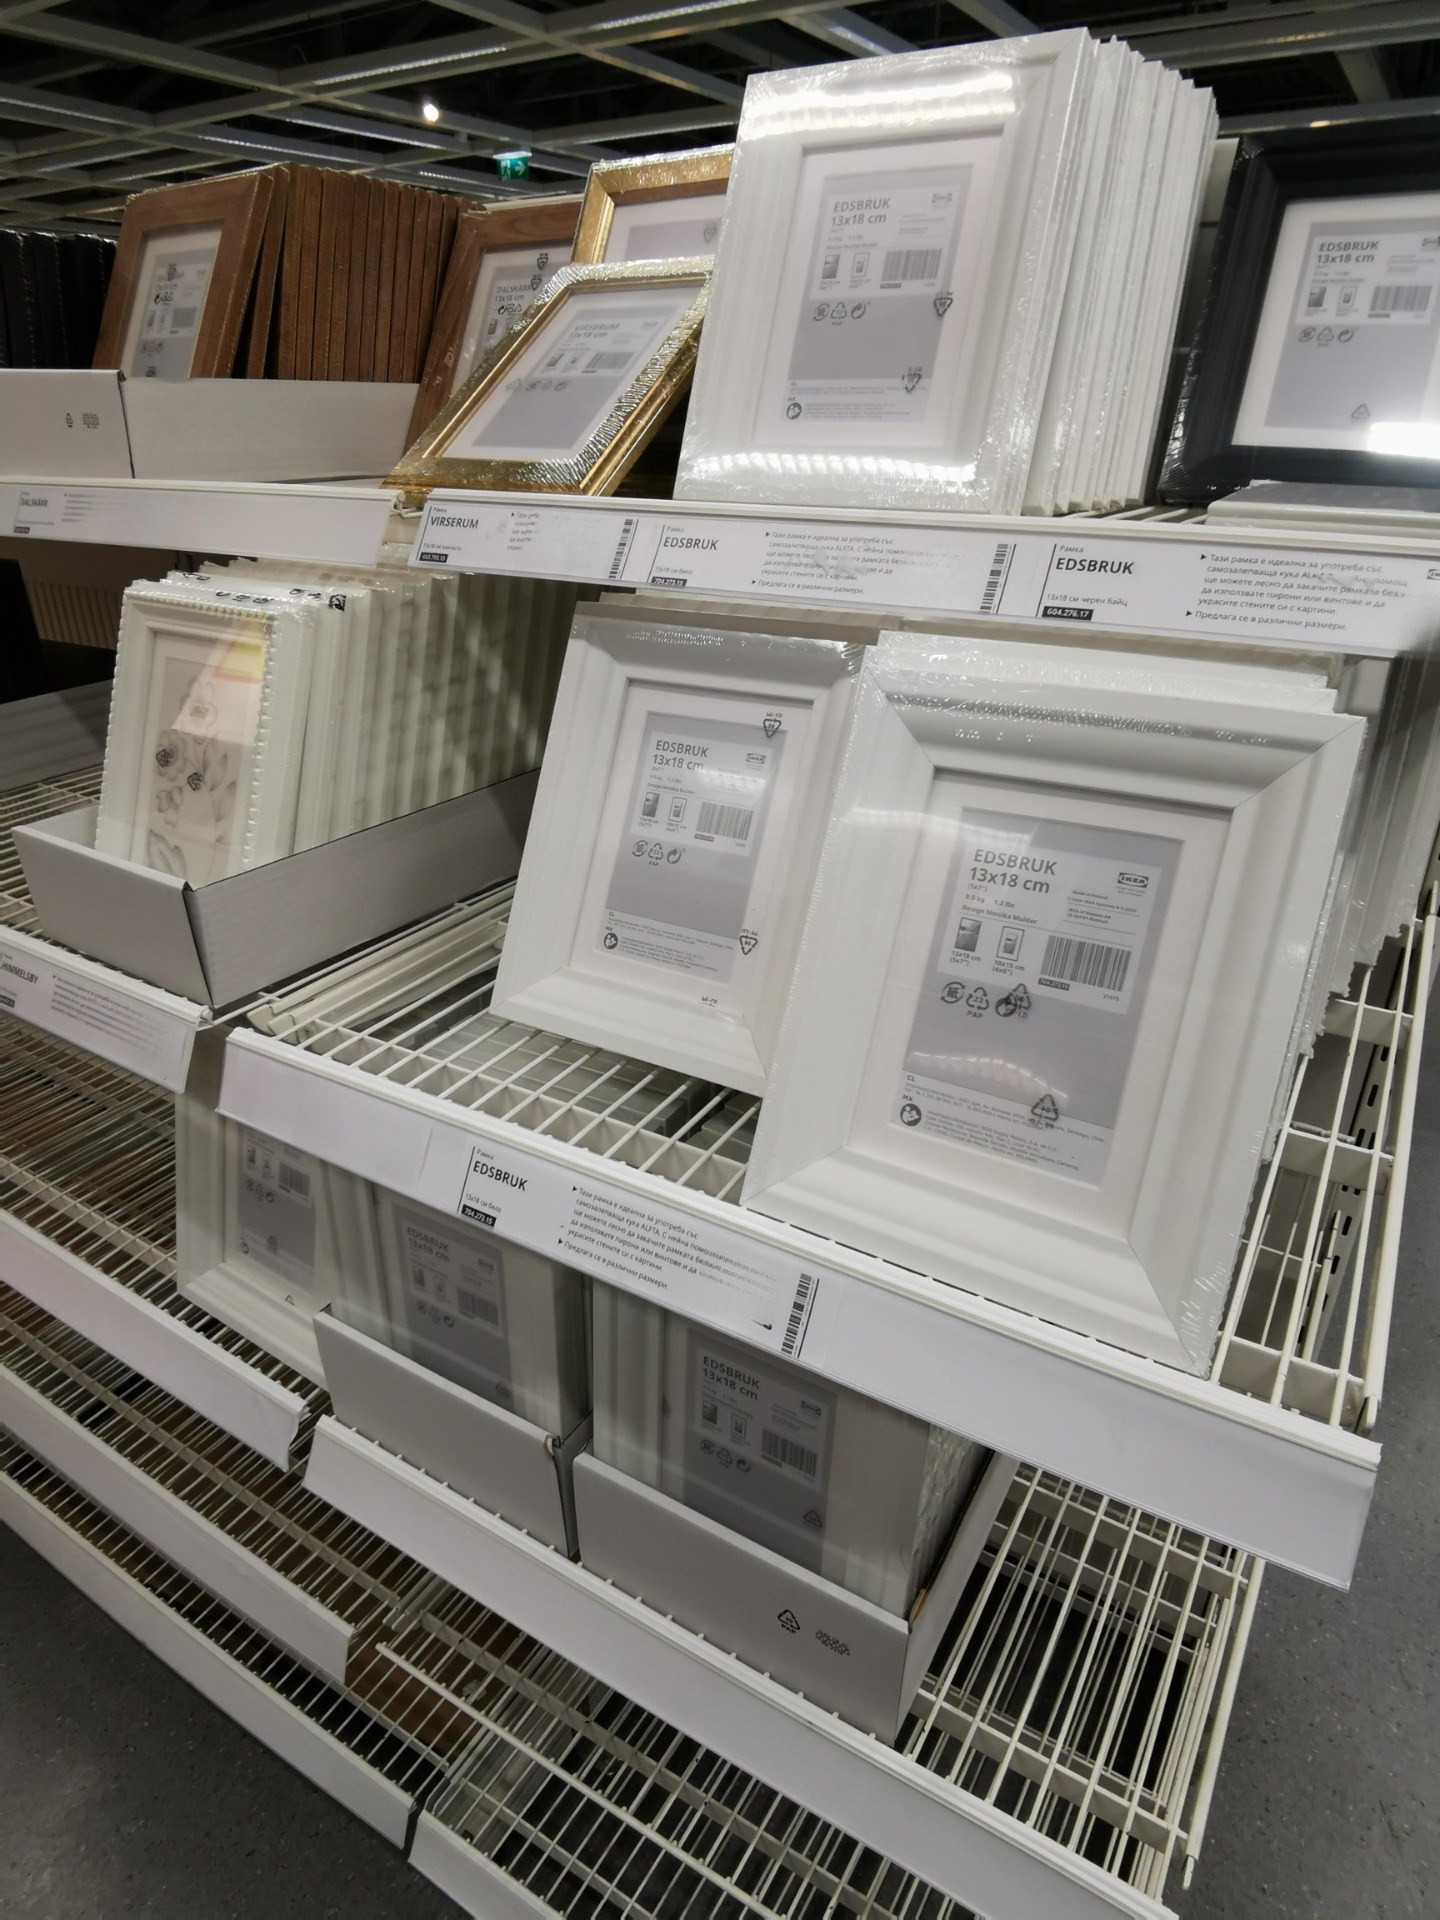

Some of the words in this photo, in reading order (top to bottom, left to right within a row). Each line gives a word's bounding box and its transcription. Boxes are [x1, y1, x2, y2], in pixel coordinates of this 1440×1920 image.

[833, 198, 891, 213] EDSBRUK
[831, 214, 865, 228] 13x18
[868, 213, 886, 224] cm
[1319, 240, 1380, 252] EDSBRUK
[1317, 253, 1351, 264] 13x18
[1355, 253, 1375, 263] cm
[430, 516, 479, 529] VIRSERUM
[663, 536, 719, 551] EDSBRUK
[1059, 545, 1084, 553] Рамка
[1056, 557, 1135, 575] EDSBRUK
[1207, 565, 1277, 577] самозалепваща
[1279, 569, 1300, 579] кука
[1210, 553, 1229, 563] Тази
[1230, 556, 1259, 567] рамка
[1268, 558, 1306, 569] идеална
[1308, 561, 1318, 569] за
[1320, 561, 1364, 573] употреба
[1366, 564, 1383, 573] със
[1204, 577, 1218, 586] ще
[1219, 577, 1252, 588] можете
[1254, 580, 1282, 589] лесно
[1283, 582, 1294, 590] да
[1295, 583, 1338, 593] закачите
[1340, 586, 1379, 596] рамката
[1046, 593, 1067, 602] 13x18
[1081, 596, 1106, 605] черен
[1197, 598, 1238, 609] украсите
[1240, 600, 1275, 610] стените
[1201, 587, 1212, 595] да
[1213, 588, 1265, 598] използвате
[1266, 591, 1301, 602] пирони
[1323, 596, 1364, 606] винтове
[1373, 601, 1385, 609] да
[1046, 607, 1090, 619] 604.276.17
[1195, 610, 1237, 623] Предлага
[1258, 617, 1303, 628] различни
[655, 740, 709, 758] EDSBRUK
[652, 754, 684, 769] 13x18
[687, 761, 704, 771] cm
[973, 848, 1058, 876] EDSBRUK
[970, 867, 1019, 888] 13x18
[1023, 878, 1050, 894] cm
[961, 904, 985, 915] Design
[986, 908, 1011, 920] Monika
[1012, 913, 1038, 925] Mulder
[2, 961, 40, 984] HIMMELSBY
[966, 1010, 983, 1018] PAP
[906, 1074, 916, 1082] CL
[902, 1094, 914, 1102] MX
[476, 1148, 494, 1160] Рамка
[473, 1160, 528, 1191] EDSBRUK
[463, 1206, 493, 1225] 704.273.15
[579, 1188, 593, 1198] Тази
[593, 1194, 613, 1206] рамка
[618, 1205, 646, 1219] идеална
[647, 1214, 654, 1222] за
[654, 1217, 685, 1235] употреба
[686, 1230, 698, 1239] със
[576, 1199, 625, 1222] самозалепваща
[626, 1218, 640, 1228] кука
[668, 1234, 689, 1247] нейна
[567, 1229, 596, 1242] украсите
[595, 1240, 621, 1254] стените
[573, 1208, 583, 1217] ще
[584, 1213, 607, 1226] можете
[607, 1222, 626, 1234] лесно
[626, 1230, 635, 1238] да
[636, 1234, 666, 1249] закачите
[666, 1244, 694, 1261] рамката
[579, 1222, 614, 1240] използвате
[615, 1236, 640, 1251] пирони
[640, 1246, 654, 1256] или
[654, 1252, 682, 1267] винтове
[688, 1265, 697, 1274] да
[564, 1241, 593, 1258] Предлага
[607, 1259, 638, 1277] различни
[703, 1355, 761, 1390] EDSBRUK
[702, 1368, 737, 1391] 13x18
[739, 1385, 759, 1400] cm
[780, 1623, 797, 1634] PAP
